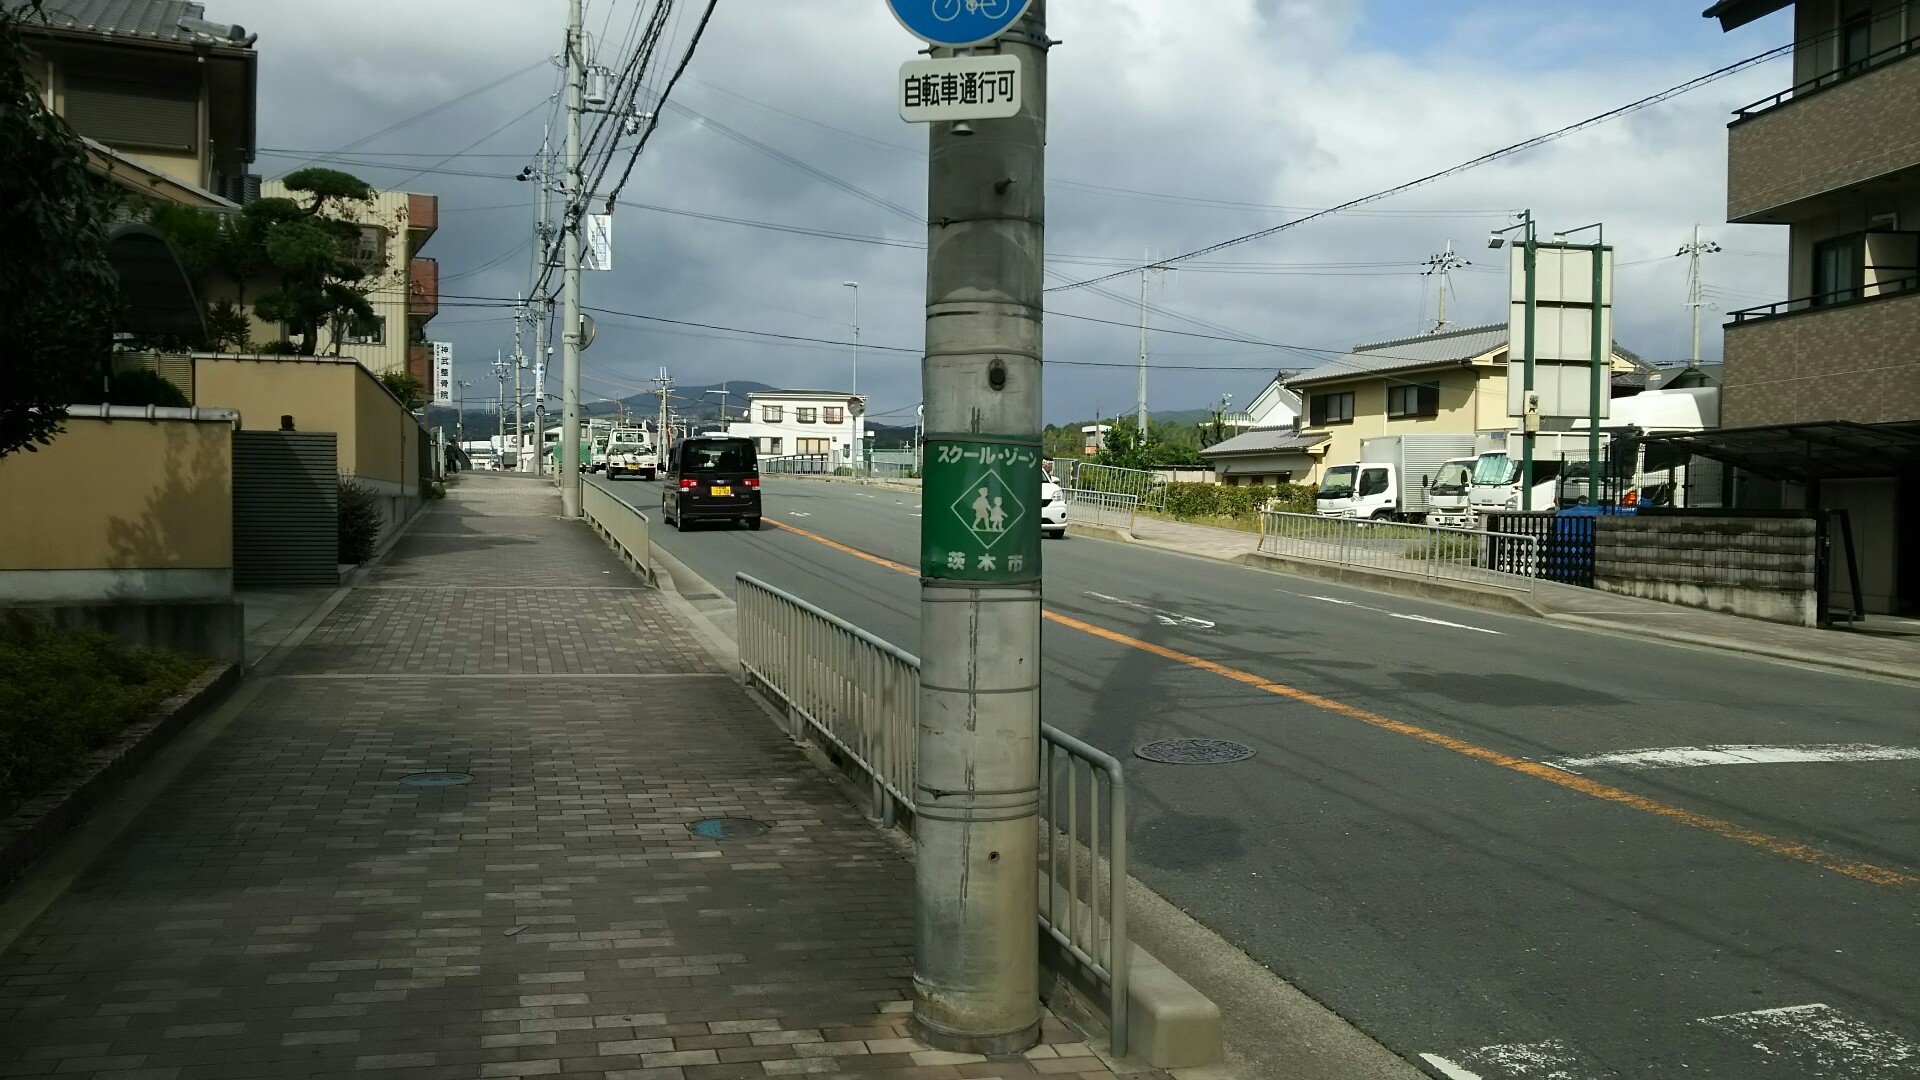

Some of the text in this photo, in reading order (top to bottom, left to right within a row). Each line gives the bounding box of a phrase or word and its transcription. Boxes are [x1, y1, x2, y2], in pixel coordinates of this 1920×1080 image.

[904, 70, 1015, 107] 自転車通行可
[938, 445, 1037, 469] スクール・ゾーン
[947, 551, 1023, 572] 茨木市
